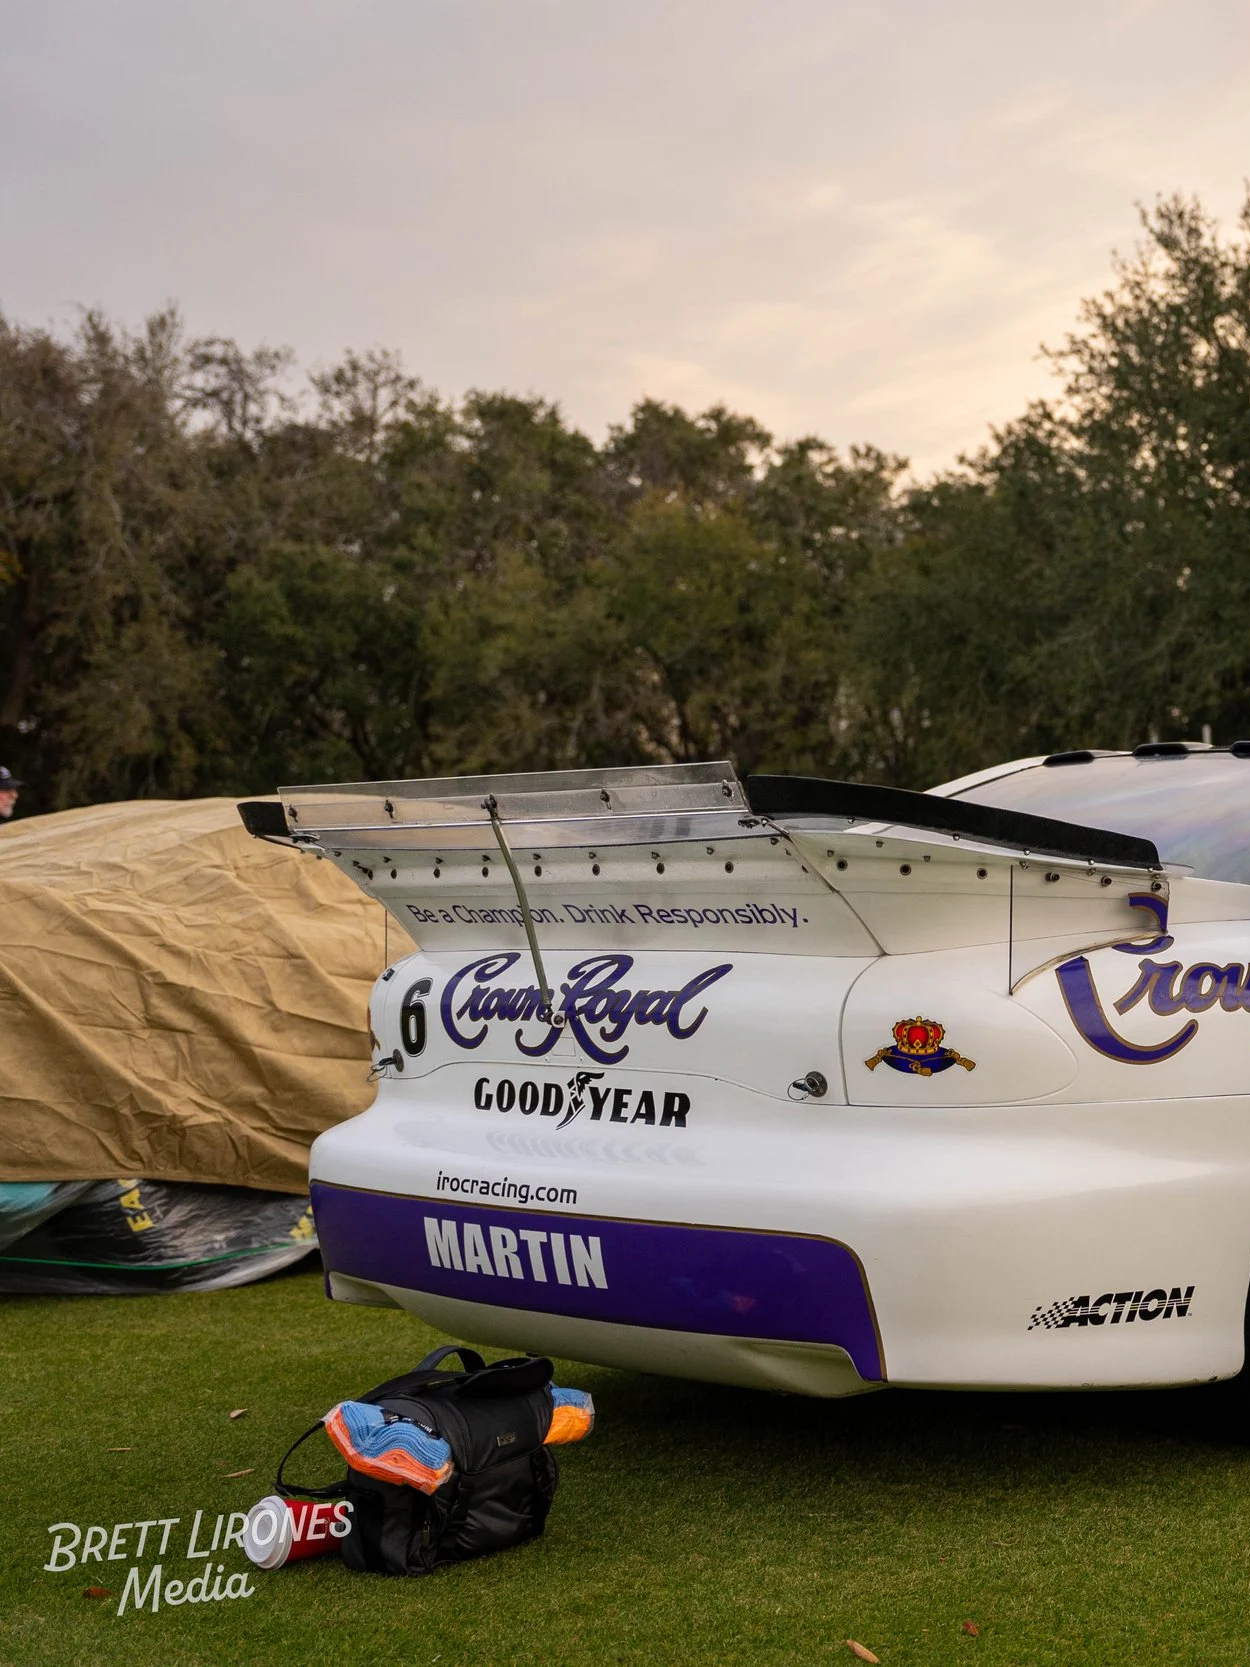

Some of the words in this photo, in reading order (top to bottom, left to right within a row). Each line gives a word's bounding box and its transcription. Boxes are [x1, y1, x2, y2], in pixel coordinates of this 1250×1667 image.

[406, 904, 439, 923] Be
[438, 909, 455, 923] a
[452, 904, 565, 928] Champon.
[562, 904, 636, 924] Drink
[632, 903, 809, 928] Responsibly.
[402, 976, 434, 1058] 6
[441, 952, 556, 1050] Crown
[515, 954, 733, 1065] Royal
[436, 1171, 578, 1205] irocracing.com
[423, 1217, 609, 1290] MARTIN
[1055, 1286, 1196, 1328] ACTION
